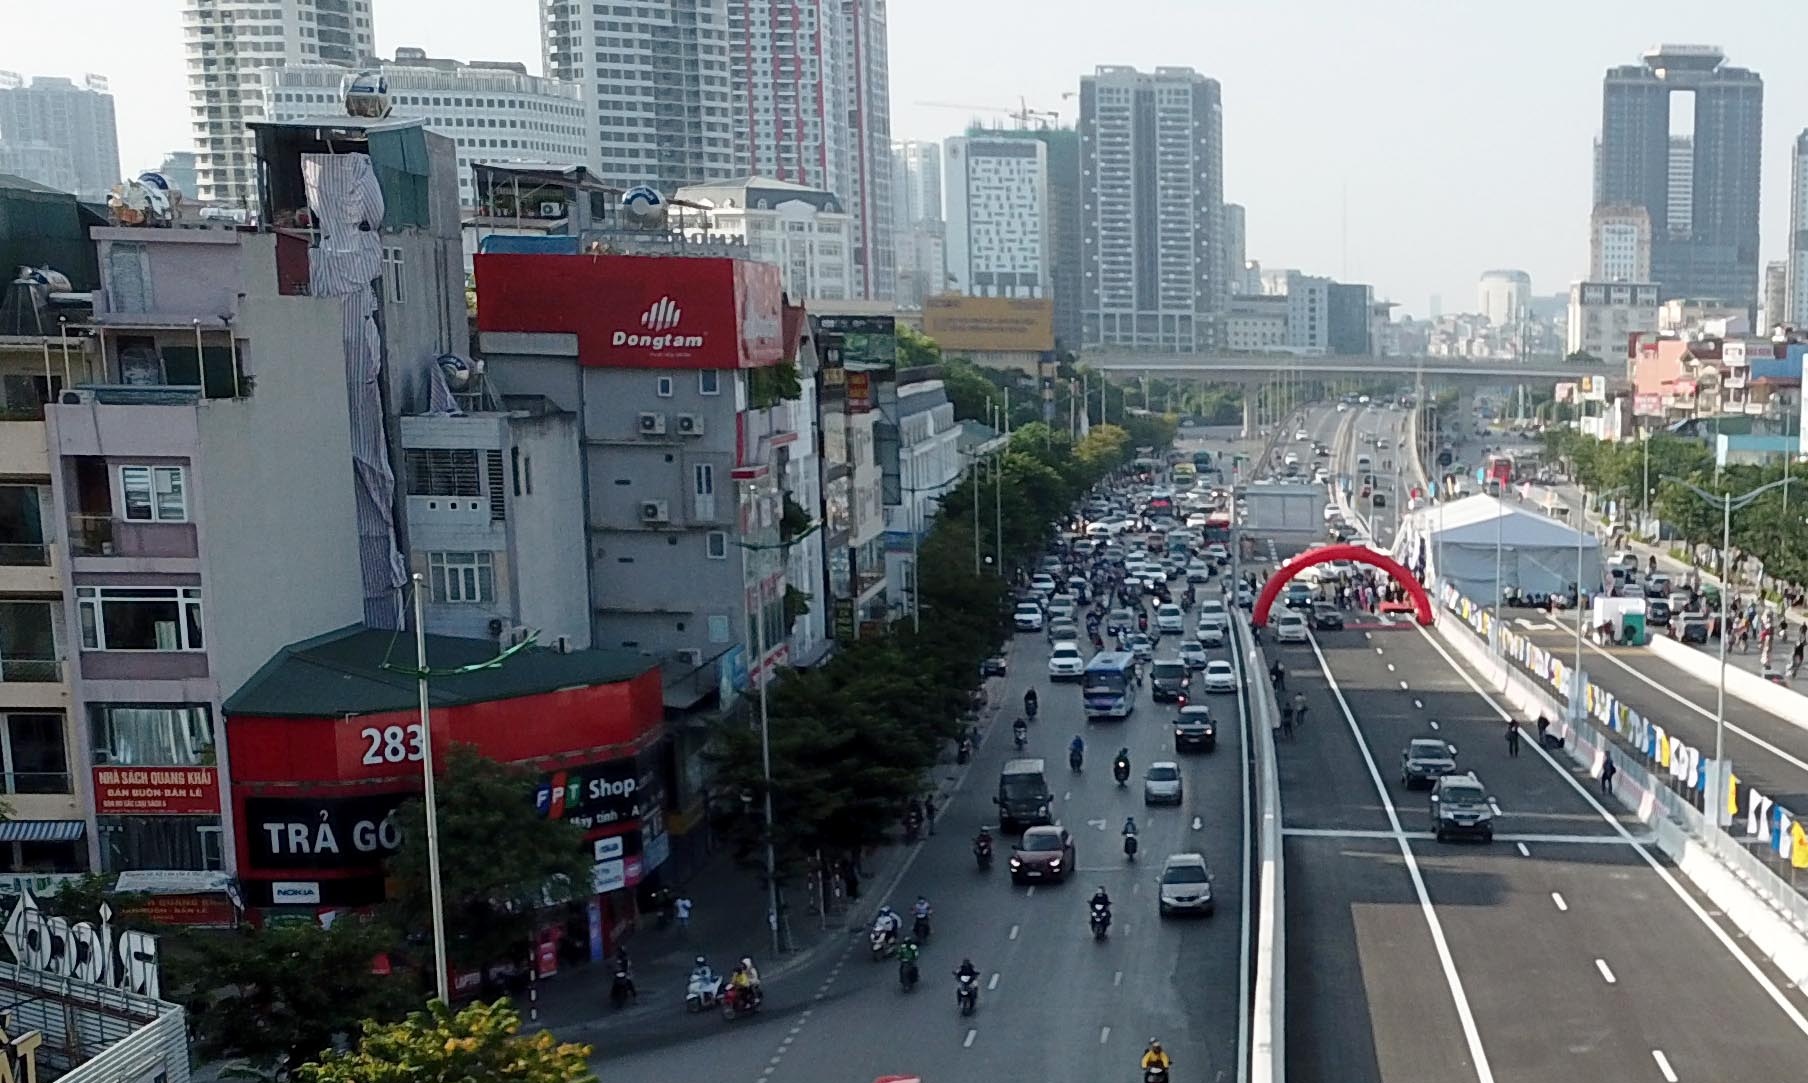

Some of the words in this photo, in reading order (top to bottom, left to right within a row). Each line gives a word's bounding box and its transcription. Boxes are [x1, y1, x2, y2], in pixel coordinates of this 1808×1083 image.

[612, 331, 703, 350] Dongtam
[361, 724, 424, 765] 283
[150, 772, 185, 785] QUANG
[263, 809, 340, 853] TRẢ
[277, 888, 314, 896] NOKIA
